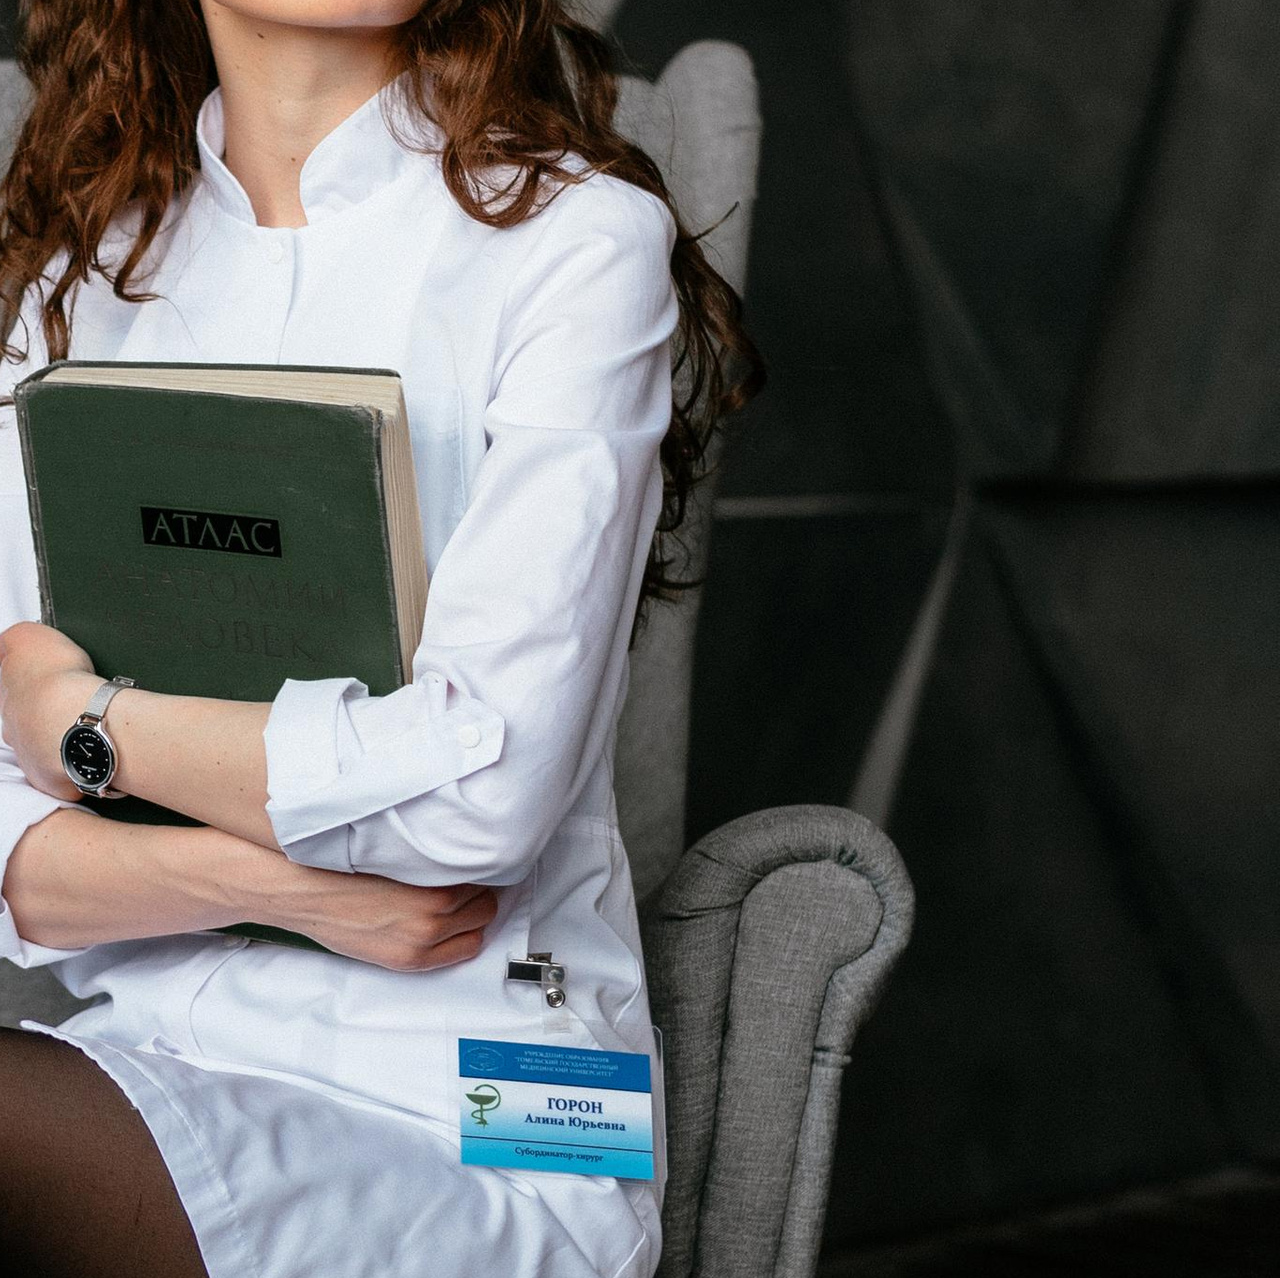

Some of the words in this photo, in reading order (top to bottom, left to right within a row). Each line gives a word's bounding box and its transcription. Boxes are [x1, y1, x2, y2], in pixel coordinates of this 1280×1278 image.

[151, 512, 275, 553] АТЛАС
[547, 1097, 603, 1114] ГОРОН
[525, 1113, 565, 1126] Алина
[568, 1116, 626, 1131] Юрьевна
[514, 1146, 604, 1163] Субординатор-хирург
